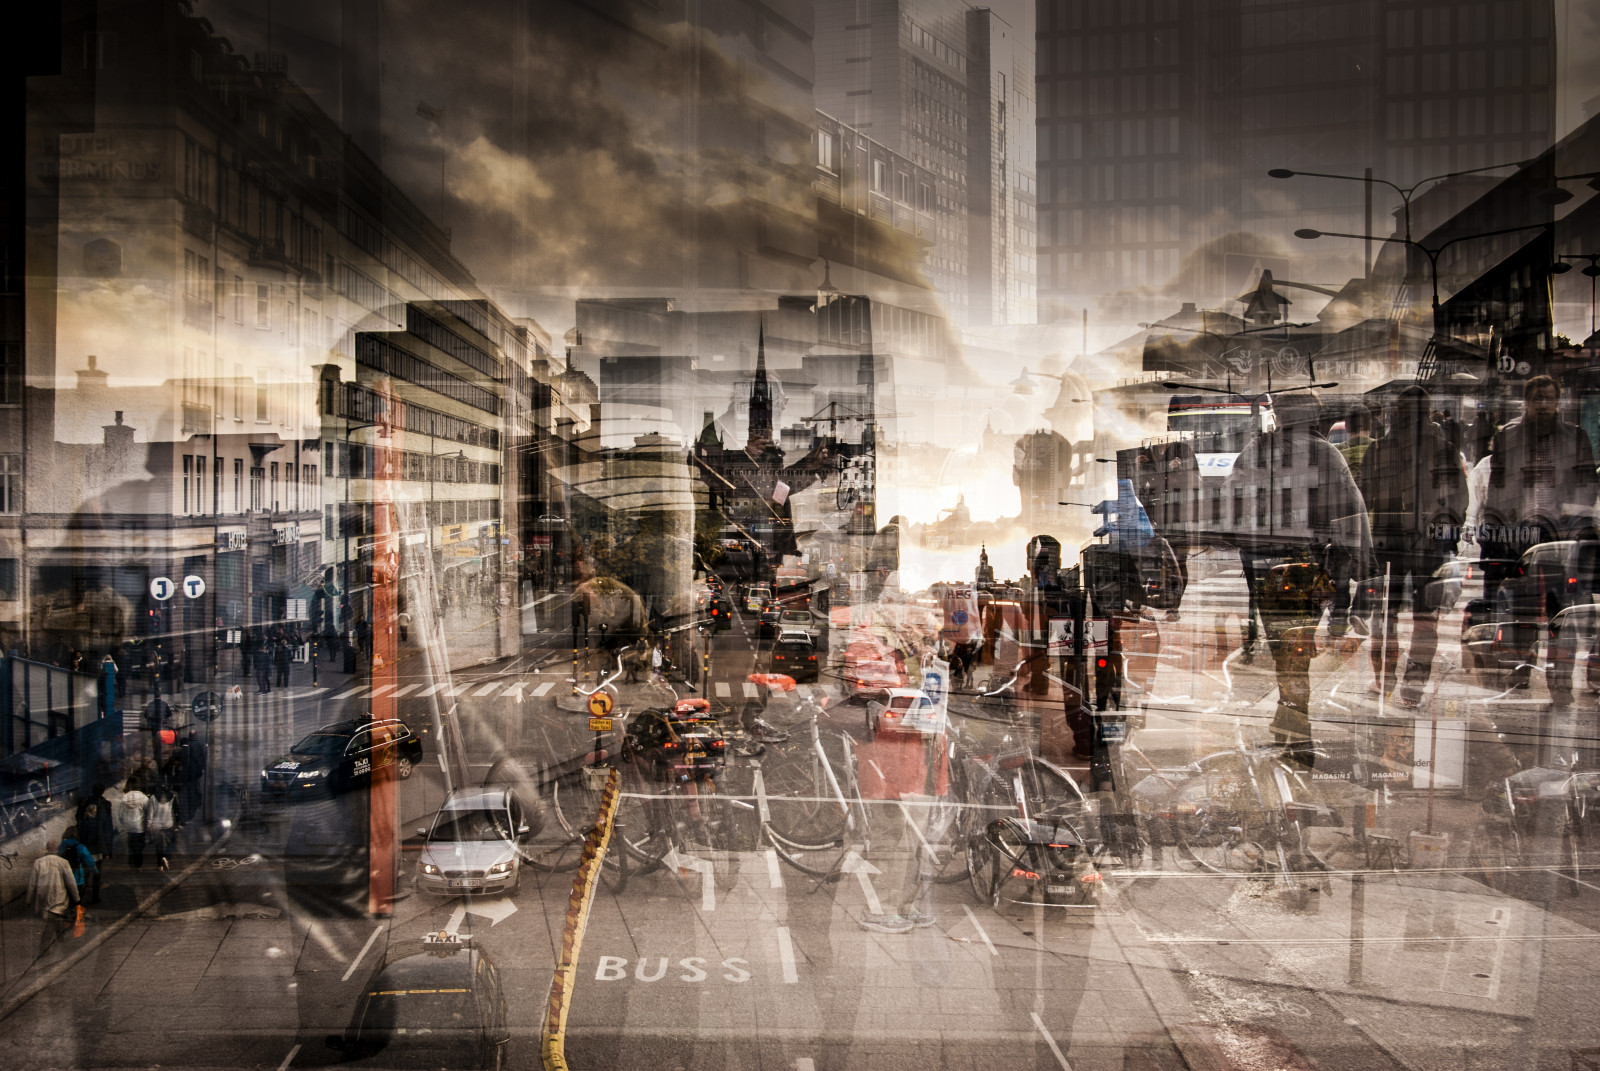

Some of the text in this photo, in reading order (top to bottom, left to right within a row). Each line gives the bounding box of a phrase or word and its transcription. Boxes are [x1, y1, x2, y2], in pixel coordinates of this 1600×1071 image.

[43, 137, 119, 155] HOTEL
[40, 158, 161, 180] TERMINUS
[1240, 350, 1251, 359] SJ
[228, 531, 248, 549] HOTEL
[156, 580, 167, 598] J
[187, 580, 200, 596] T
[354, 757, 369, 768] TAXI
[428, 935, 457, 943] TAXI
[595, 955, 751, 983] BUSS
